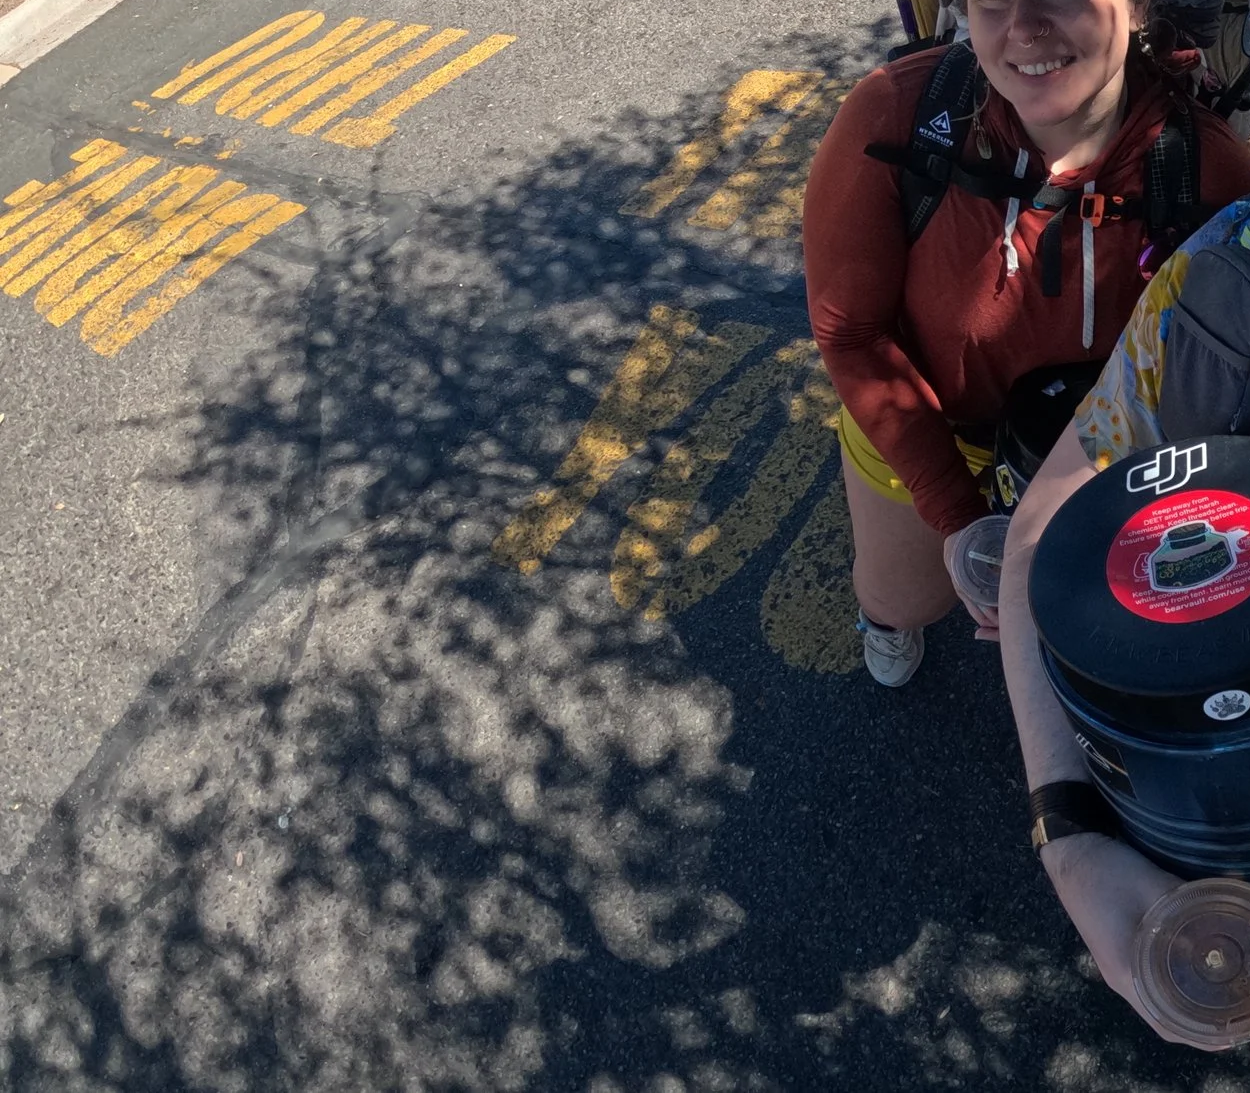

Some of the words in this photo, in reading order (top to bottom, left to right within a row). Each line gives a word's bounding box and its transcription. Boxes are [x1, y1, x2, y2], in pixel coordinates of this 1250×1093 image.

[918, 127, 954, 147] HYPERLITE
[1143, 516, 1163, 526] DEET
[1164, 512, 1179, 521] and
[1178, 507, 1199, 516] other
[1198, 500, 1220, 511] harsh
[1152, 507, 1171, 517] Keep
[1172, 502, 1191, 511] away
[1191, 496, 1210, 505] from
[1167, 518, 1188, 527] Keep
[1187, 509, 1216, 521] threads
[1216, 502, 1239, 513] clean.
[1119, 536, 1146, 547] Ensure
[1210, 510, 1235, 522] before
[1235, 505, 1248, 515] trip.
[1132, 589, 1153, 599] Keep
[1135, 595, 1156, 606] while
[1148, 600, 1170, 611] away
[1170, 595, 1190, 605] from
[1189, 590, 1209, 600] tent.
[1209, 583, 1233, 595] Learn
[1164, 586, 1246, 614] bearvault.com/use
